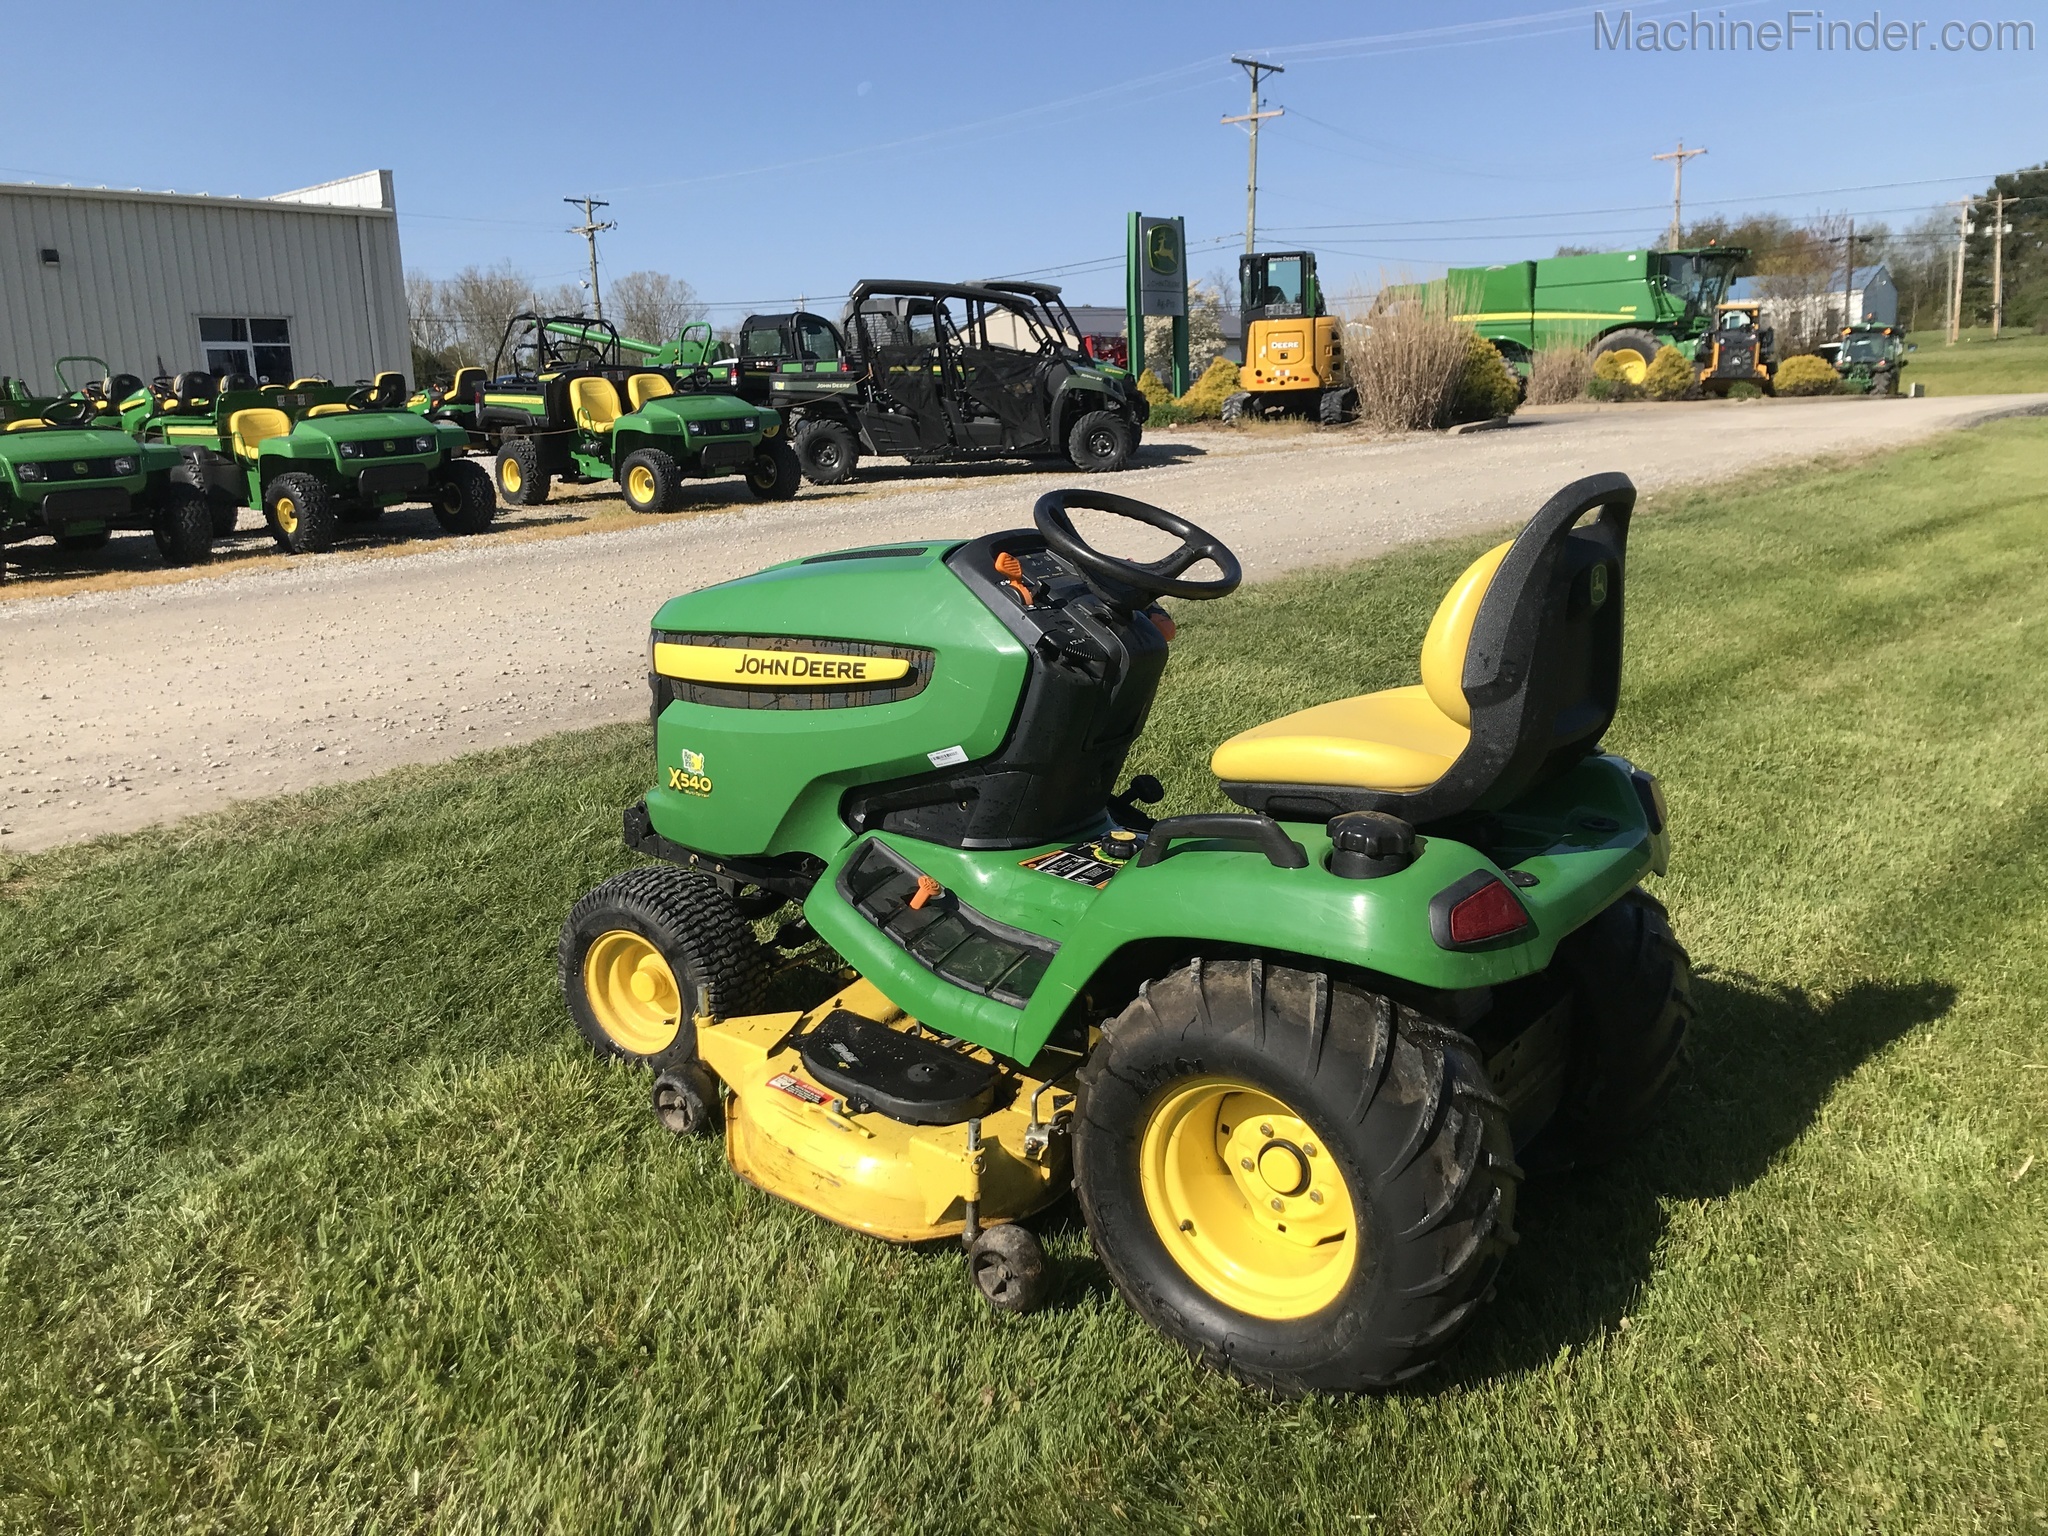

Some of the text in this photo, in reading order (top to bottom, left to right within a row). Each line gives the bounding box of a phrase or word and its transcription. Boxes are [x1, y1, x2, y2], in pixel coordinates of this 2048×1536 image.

[1271, 341, 1299, 349] DEERE
[735, 654, 866, 679] JOHN DEERE
[669, 766, 712, 792] X540
